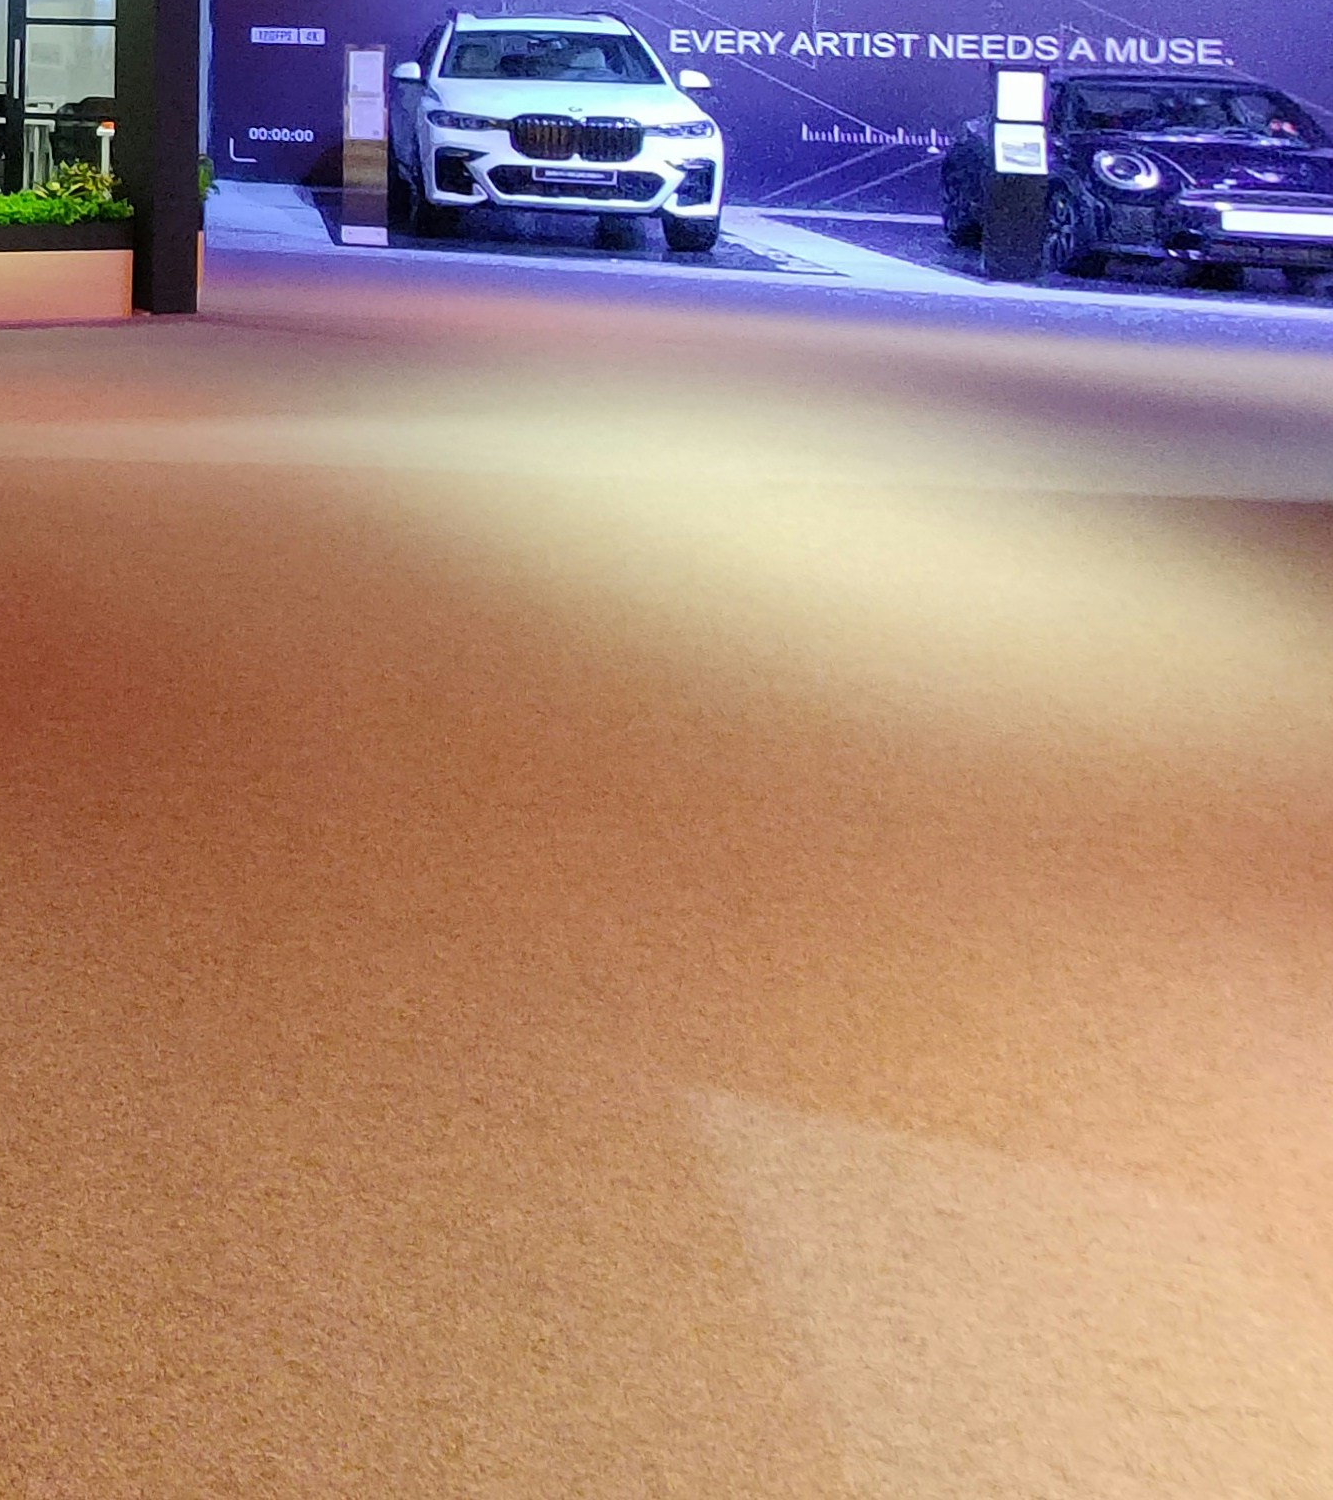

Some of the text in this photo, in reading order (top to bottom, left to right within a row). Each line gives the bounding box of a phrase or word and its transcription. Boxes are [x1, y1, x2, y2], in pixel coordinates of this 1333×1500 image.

[669, 29, 1235, 66] EVERY ARTIST NEEDS A MUSE.
[248, 127, 314, 142] 00:00:00
